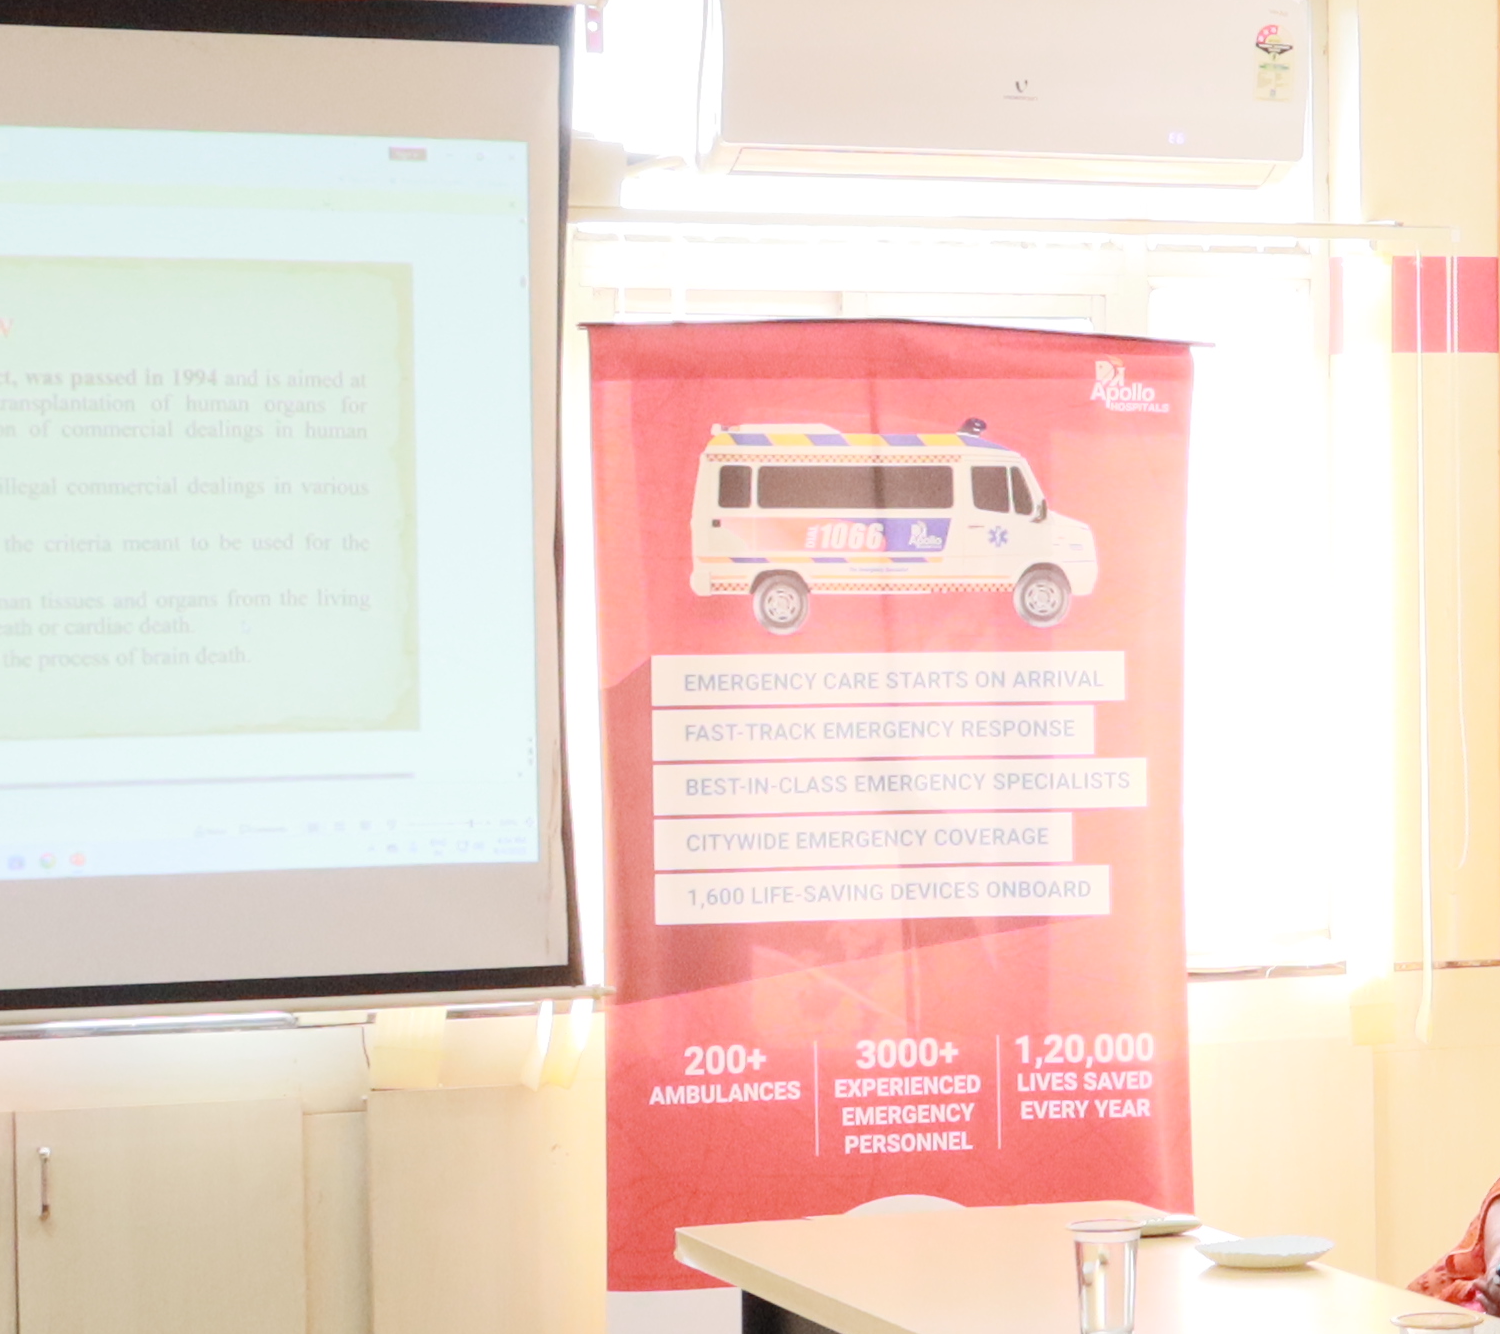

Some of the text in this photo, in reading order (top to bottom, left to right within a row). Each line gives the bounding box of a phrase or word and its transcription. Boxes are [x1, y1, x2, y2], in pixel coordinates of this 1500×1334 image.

[24, 373, 64, 386] was
[69, 368, 138, 391] passed
[144, 369, 164, 387] in
[173, 369, 219, 387] 1994
[224, 369, 259, 387] and
[265, 372, 282, 387] is
[286, 370, 344, 389] aimed
[350, 372, 367, 388] at
[149, 394, 174, 413] of
[184, 395, 250, 413] human
[263, 400, 327, 418] organs
[340, 396, 368, 414] for
[1089, 381, 1156, 409] Apollo
[1110, 401, 1170, 414] HOSPITALS
[28, 420, 52, 438] of
[60, 420, 174, 438] commercial
[183, 420, 265, 443] dealings
[274, 422, 294, 438] in
[304, 420, 369, 440] human
[65, 477, 178, 496] commercial
[185, 477, 266, 500] dealings
[273, 479, 293, 496] in
[300, 479, 370, 496] various
[3, 534, 35, 553] the
[43, 535, 113, 553] criteria
[121, 536, 181, 552] meant
[190, 536, 211, 552] to
[218, 534, 243, 552] be
[251, 532, 294, 552] used
[303, 533, 332, 551] for
[341, 533, 370, 552] the
[819, 522, 885, 550] 1066
[39, 593, 106, 610] tissues
[112, 591, 148, 609] and
[154, 595, 219, 613] organs
[226, 589, 272, 608] from
[278, 589, 309, 608] the
[316, 588, 372, 612] living
[36, 623, 60, 636] or
[63, 617, 134, 636] cardiac
[137, 615, 197, 635] death.
[2, 649, 33, 668] the
[37, 654, 111, 673] process
[114, 647, 138, 667] of
[140, 646, 191, 666] brain
[194, 646, 252, 665] death.
[683, 669, 1105, 693] EMERGENCY CARE STARTS ON ARRIVAL
[683, 718, 1075, 744] FAST-TRACK EMERGENCY RESPONSE
[684, 770, 1130, 797] BEST-IN-CLASS EMERGENCY SPECIALISTS
[685, 826, 1049, 853] CITYWIDE EMERGENCY COVERAGE
[687, 878, 1092, 909] 1,600 LIFE-SAVING DEVICES ONBOARD
[685, 1044, 766, 1075] 200+
[857, 1037, 959, 1068] 3000+
[1015, 1033, 1154, 1068] 1,20,000
[649, 1081, 801, 1105] AMBULANCES
[835, 1074, 981, 1098] EXPERIENCED
[1017, 1071, 1152, 1092] LIVES SAVED
[842, 1103, 974, 1126] EMERGENCY
[1021, 1099, 1150, 1120] EVERY YEAR
[845, 1131, 973, 1154] PERSONNEL
